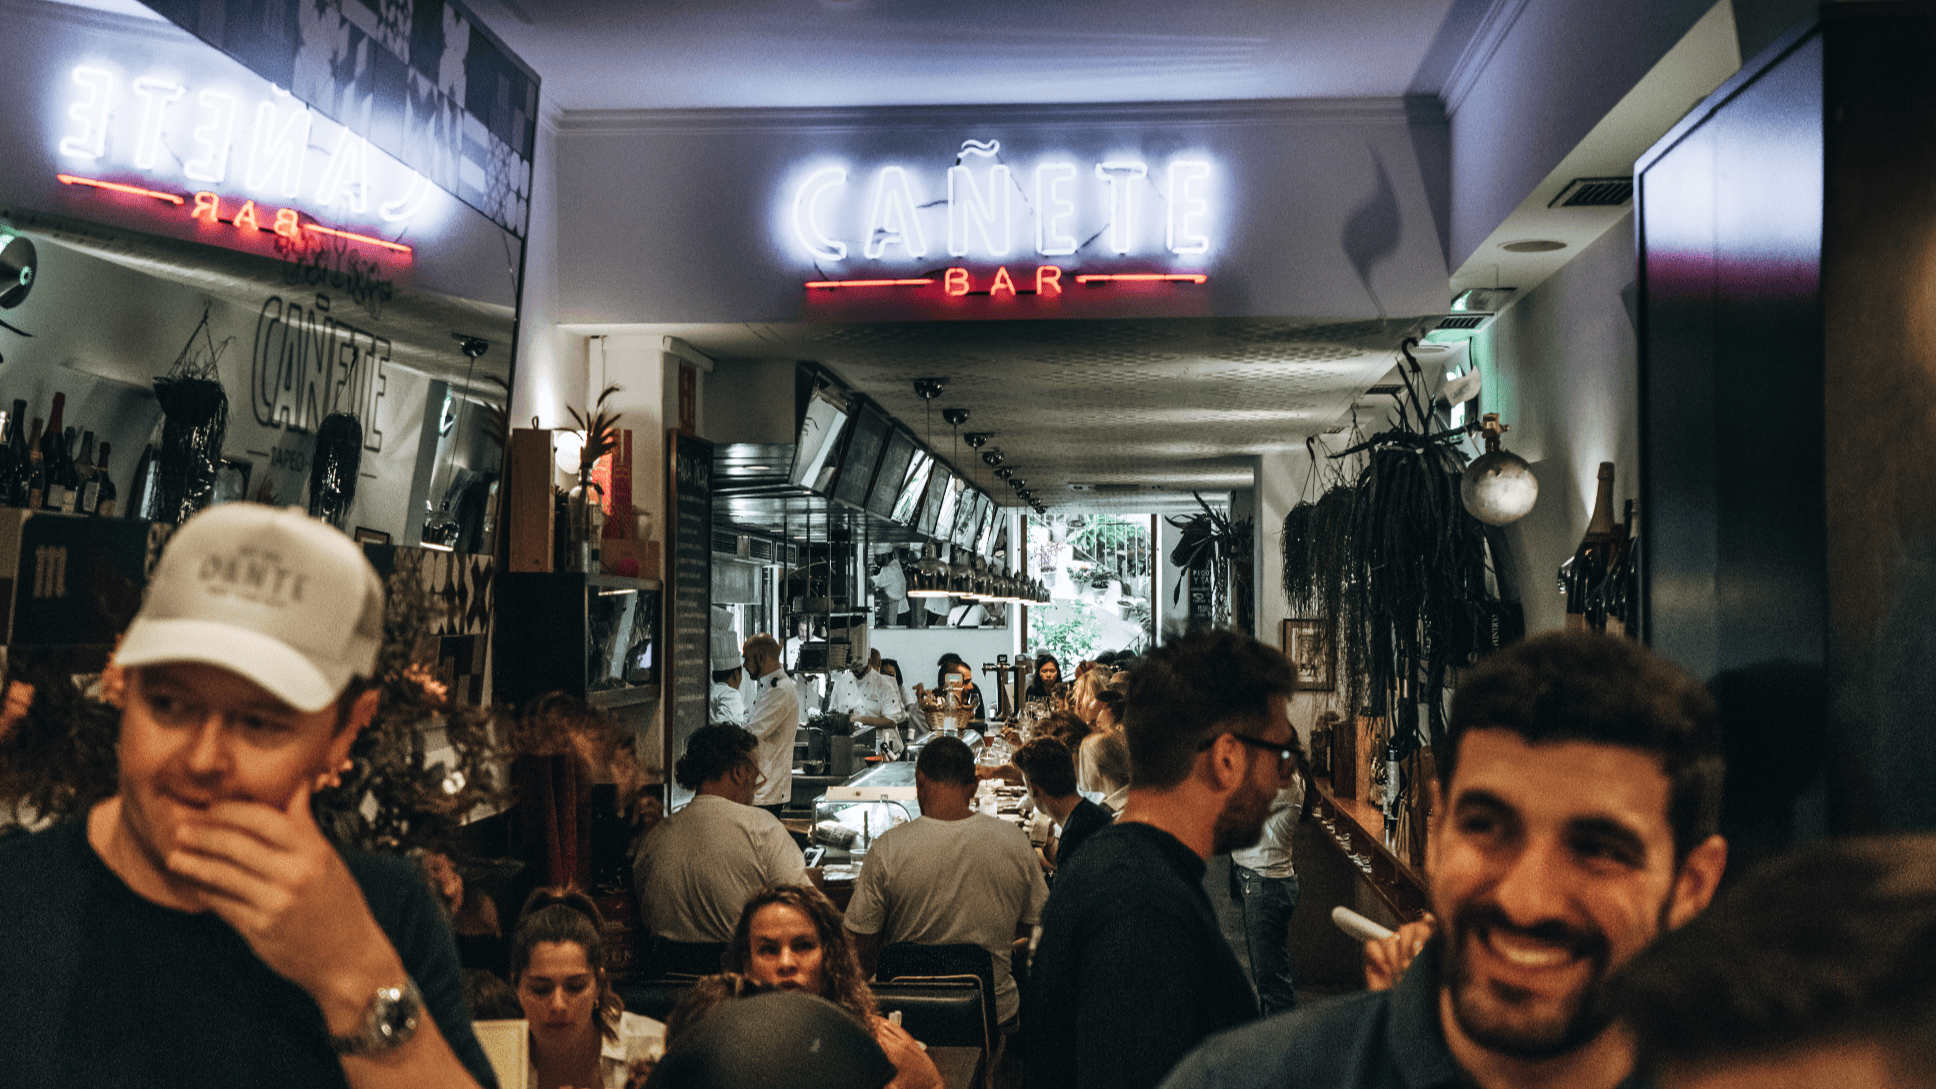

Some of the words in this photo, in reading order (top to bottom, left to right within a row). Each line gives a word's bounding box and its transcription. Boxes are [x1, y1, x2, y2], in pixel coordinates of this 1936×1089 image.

[793, 140, 1211, 260] CAÑETE
[945, 265, 1062, 297] BAR
[252, 293, 391, 453] CAÑETE
